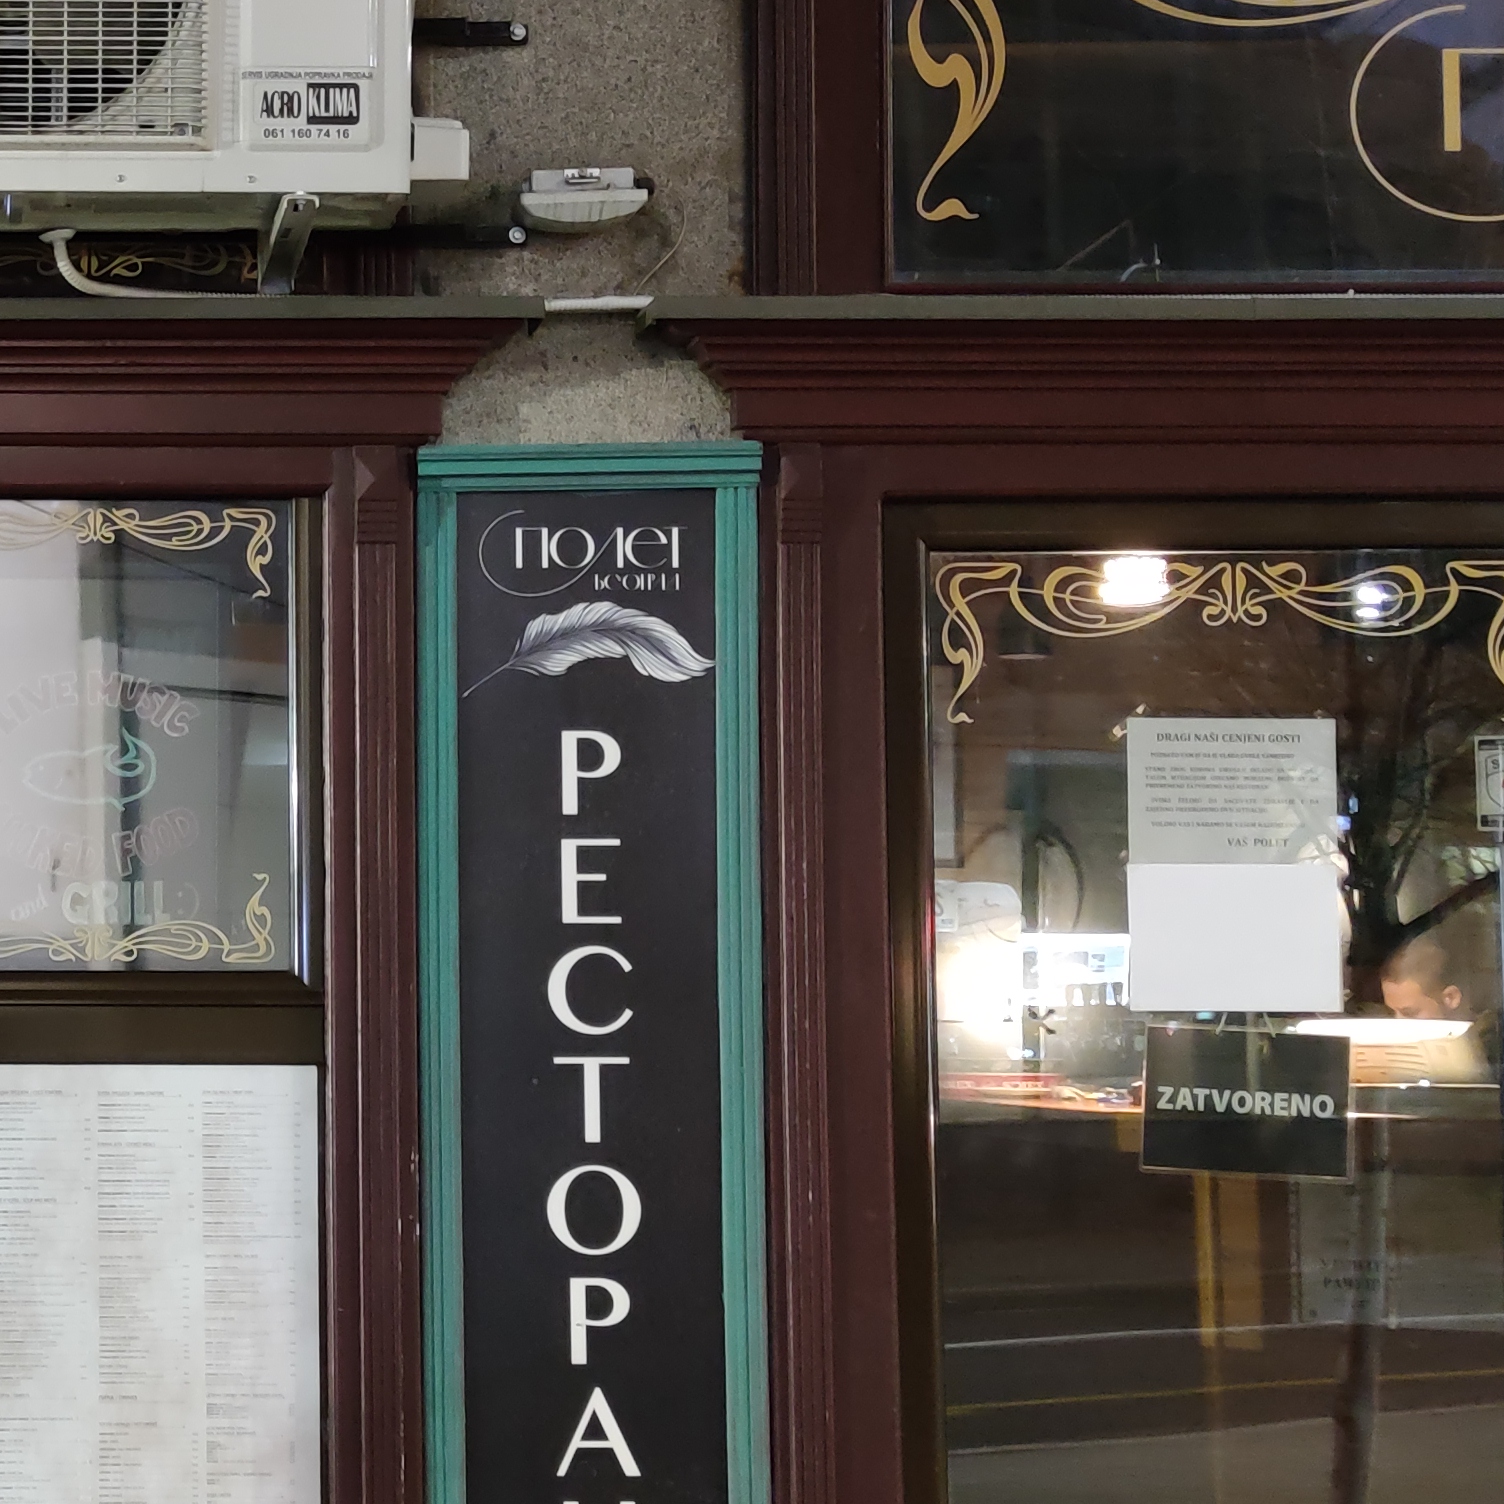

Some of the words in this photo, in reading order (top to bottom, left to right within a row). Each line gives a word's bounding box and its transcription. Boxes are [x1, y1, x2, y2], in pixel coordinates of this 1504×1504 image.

[260, 90, 302, 119] ACRO
[308, 87, 357, 117] KLIMA
[263, 128, 285, 139] 061
[291, 128, 312, 139] 160
[316, 128, 330, 139] 74
[336, 128, 350, 139] 16
[87, 671, 201, 738] MUSIC
[1156, 732, 1191, 743] DRAGI
[1194, 731, 1219, 743] NAŠI
[1222, 733, 1265, 744] CENJENI
[1268, 734, 1301, 744] GOSTI
[112, 806, 199, 877] FOOD
[61, 879, 171, 926] GRILL
[1156, 1084, 1335, 1120] ZATVORENO
